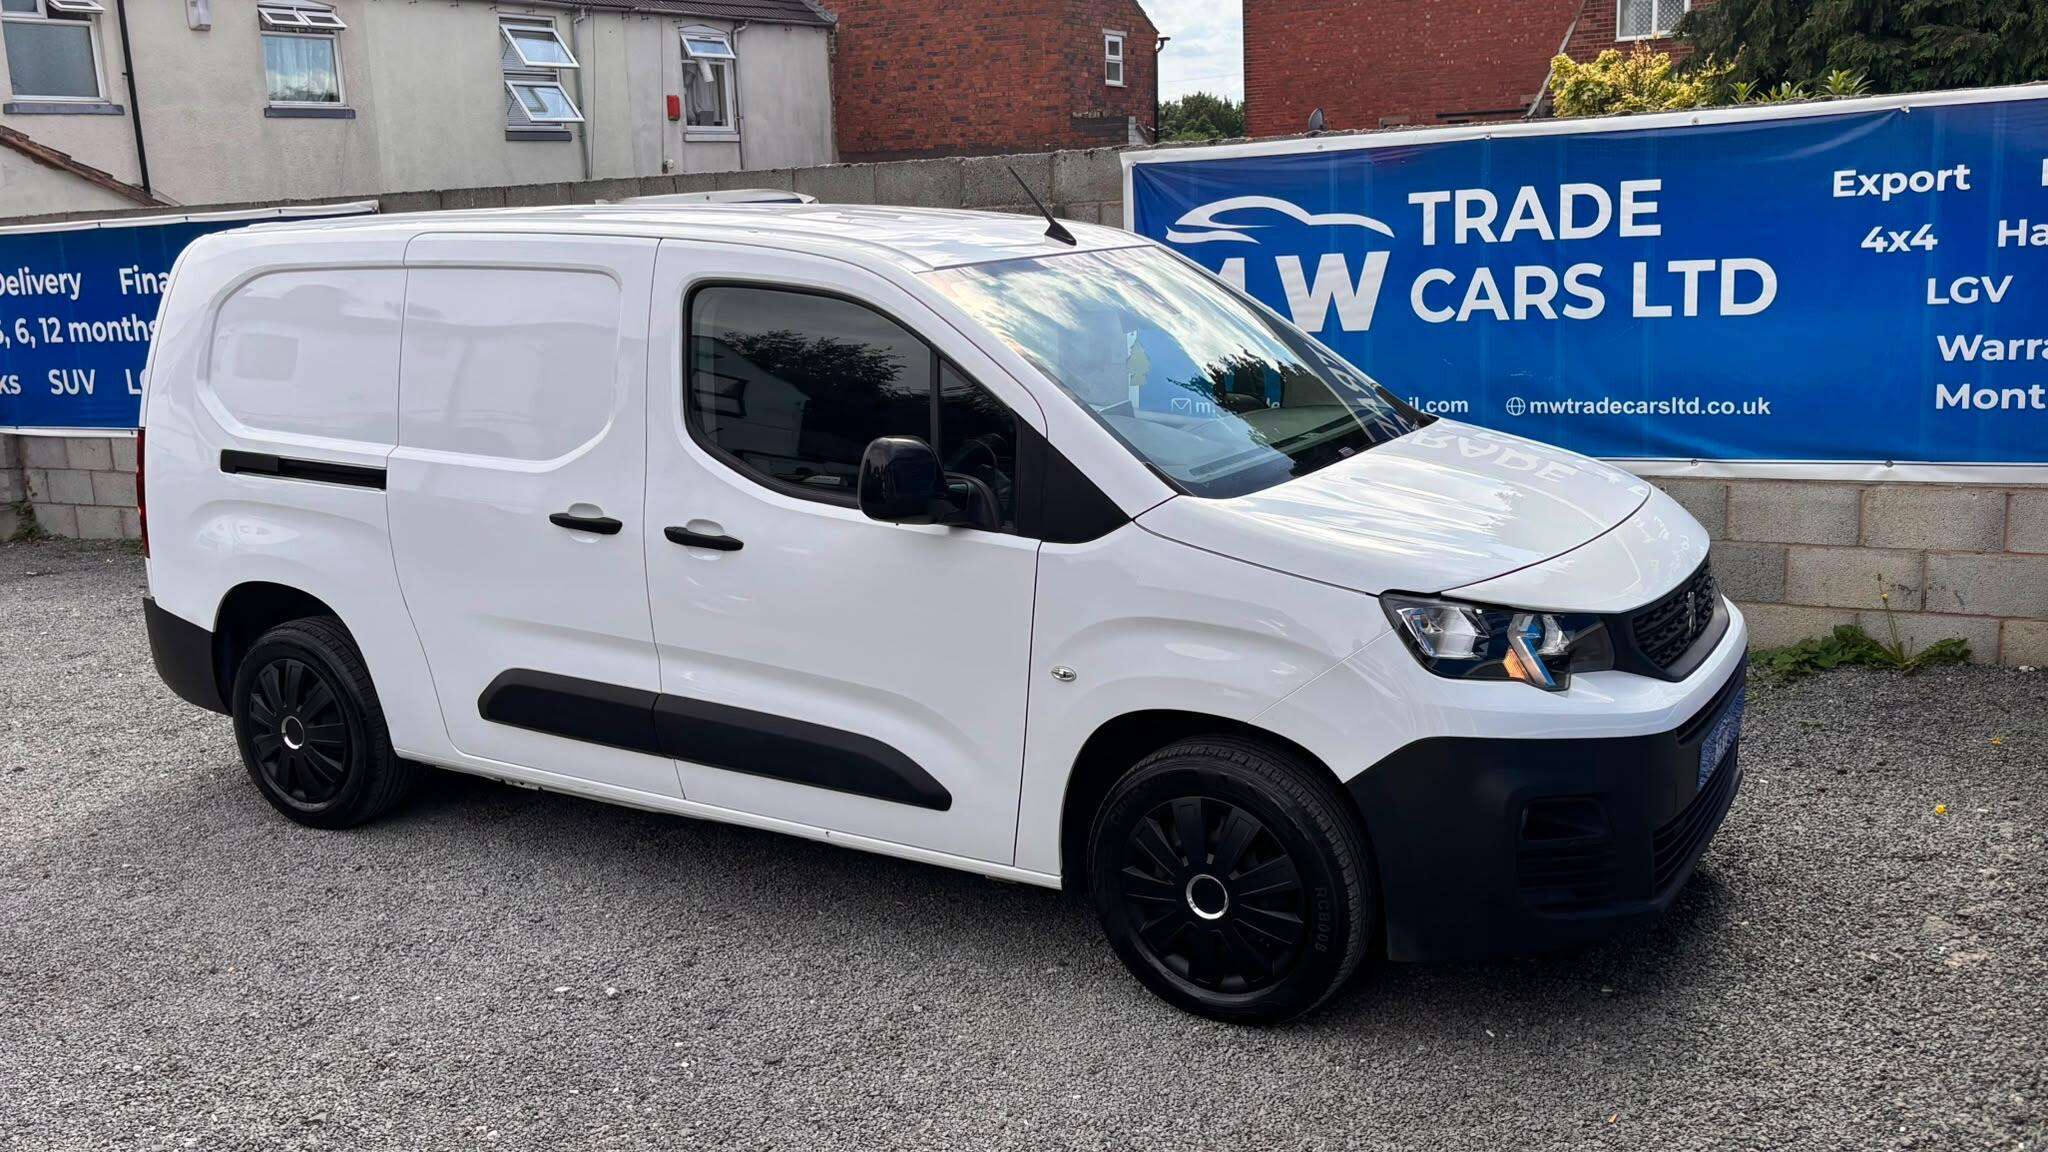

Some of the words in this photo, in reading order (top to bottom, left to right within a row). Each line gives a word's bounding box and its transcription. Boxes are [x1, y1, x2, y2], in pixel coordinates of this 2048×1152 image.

[1833, 164, 1971, 202] Export
[1408, 178, 1662, 246] TRADE
[1860, 223, 1938, 253] 4x4
[1410, 262, 1606, 323] CARS
[1632, 257, 1778, 318] LTD
[1927, 275, 2014, 305] LGV
[14, 318, 36, 349] 6,
[39, 316, 64, 343] 12
[1936, 334, 2048, 362] Warr
[48, 368, 96, 395] SUV
[1935, 383, 2046, 410] Mont
[1530, 396, 1771, 415] mwtradecarsltd.co.uk
